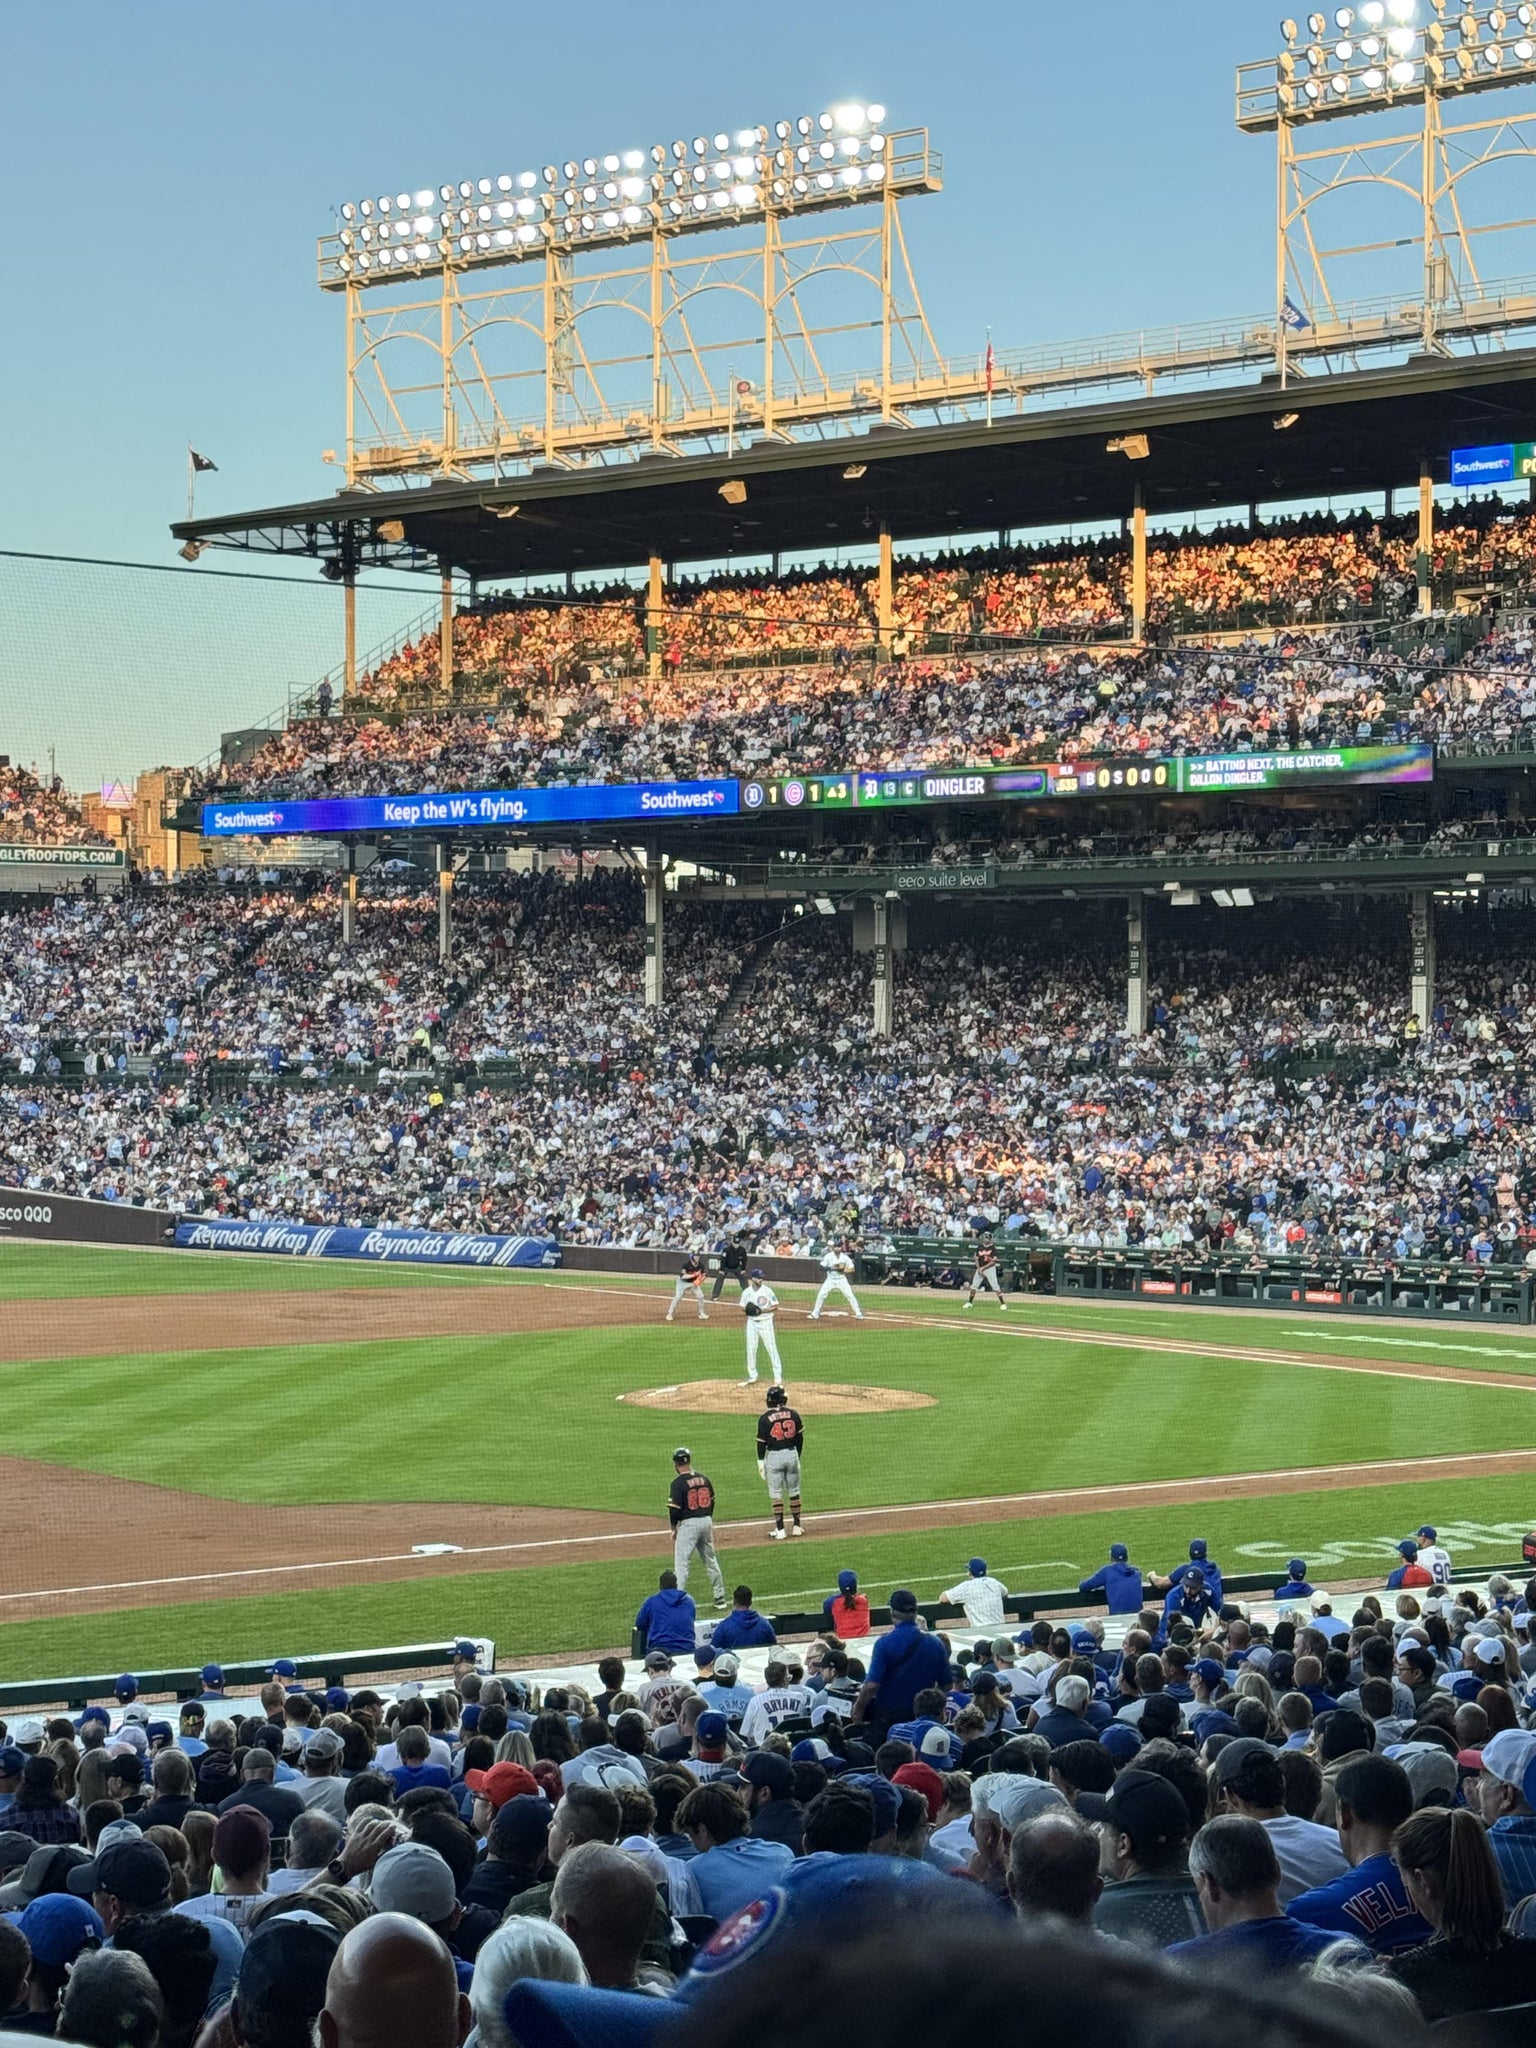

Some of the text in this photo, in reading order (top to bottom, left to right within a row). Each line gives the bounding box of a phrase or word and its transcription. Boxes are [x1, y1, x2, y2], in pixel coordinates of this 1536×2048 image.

[1454, 460, 1504, 473] Southwest
[1206, 754, 1344, 772] BATTING NEXT, THE CATCHER,
[1099, 769, 1110, 788] 0
[1113, 771, 1123, 784] S
[1126, 768, 1138, 786] 0
[1154, 766, 1166, 785] 0
[1190, 771, 1266, 786] DILLON DINGLER.
[769, 786, 777, 804] 1
[810, 784, 818, 801] 1
[837, 782, 847, 799] 3
[884, 782, 896, 795] 13
[905, 782, 913, 794] C
[926, 777, 985, 796] DINGLER
[641, 790, 715, 809] Southwest
[214, 811, 276, 828] Southwest
[384, 797, 528, 824] Keep the W's flying.
[0, 849, 116, 863] GLEYROOFTOPS.COM
[899, 871, 987, 888] eero suite level
[24, 1205, 52, 1223] QQQ
[188, 1225, 308, 1255] Reynolds Wrap
[360, 1231, 497, 1263] Reynolds Wrap
[763, 1698, 801, 1715] BRYANT
